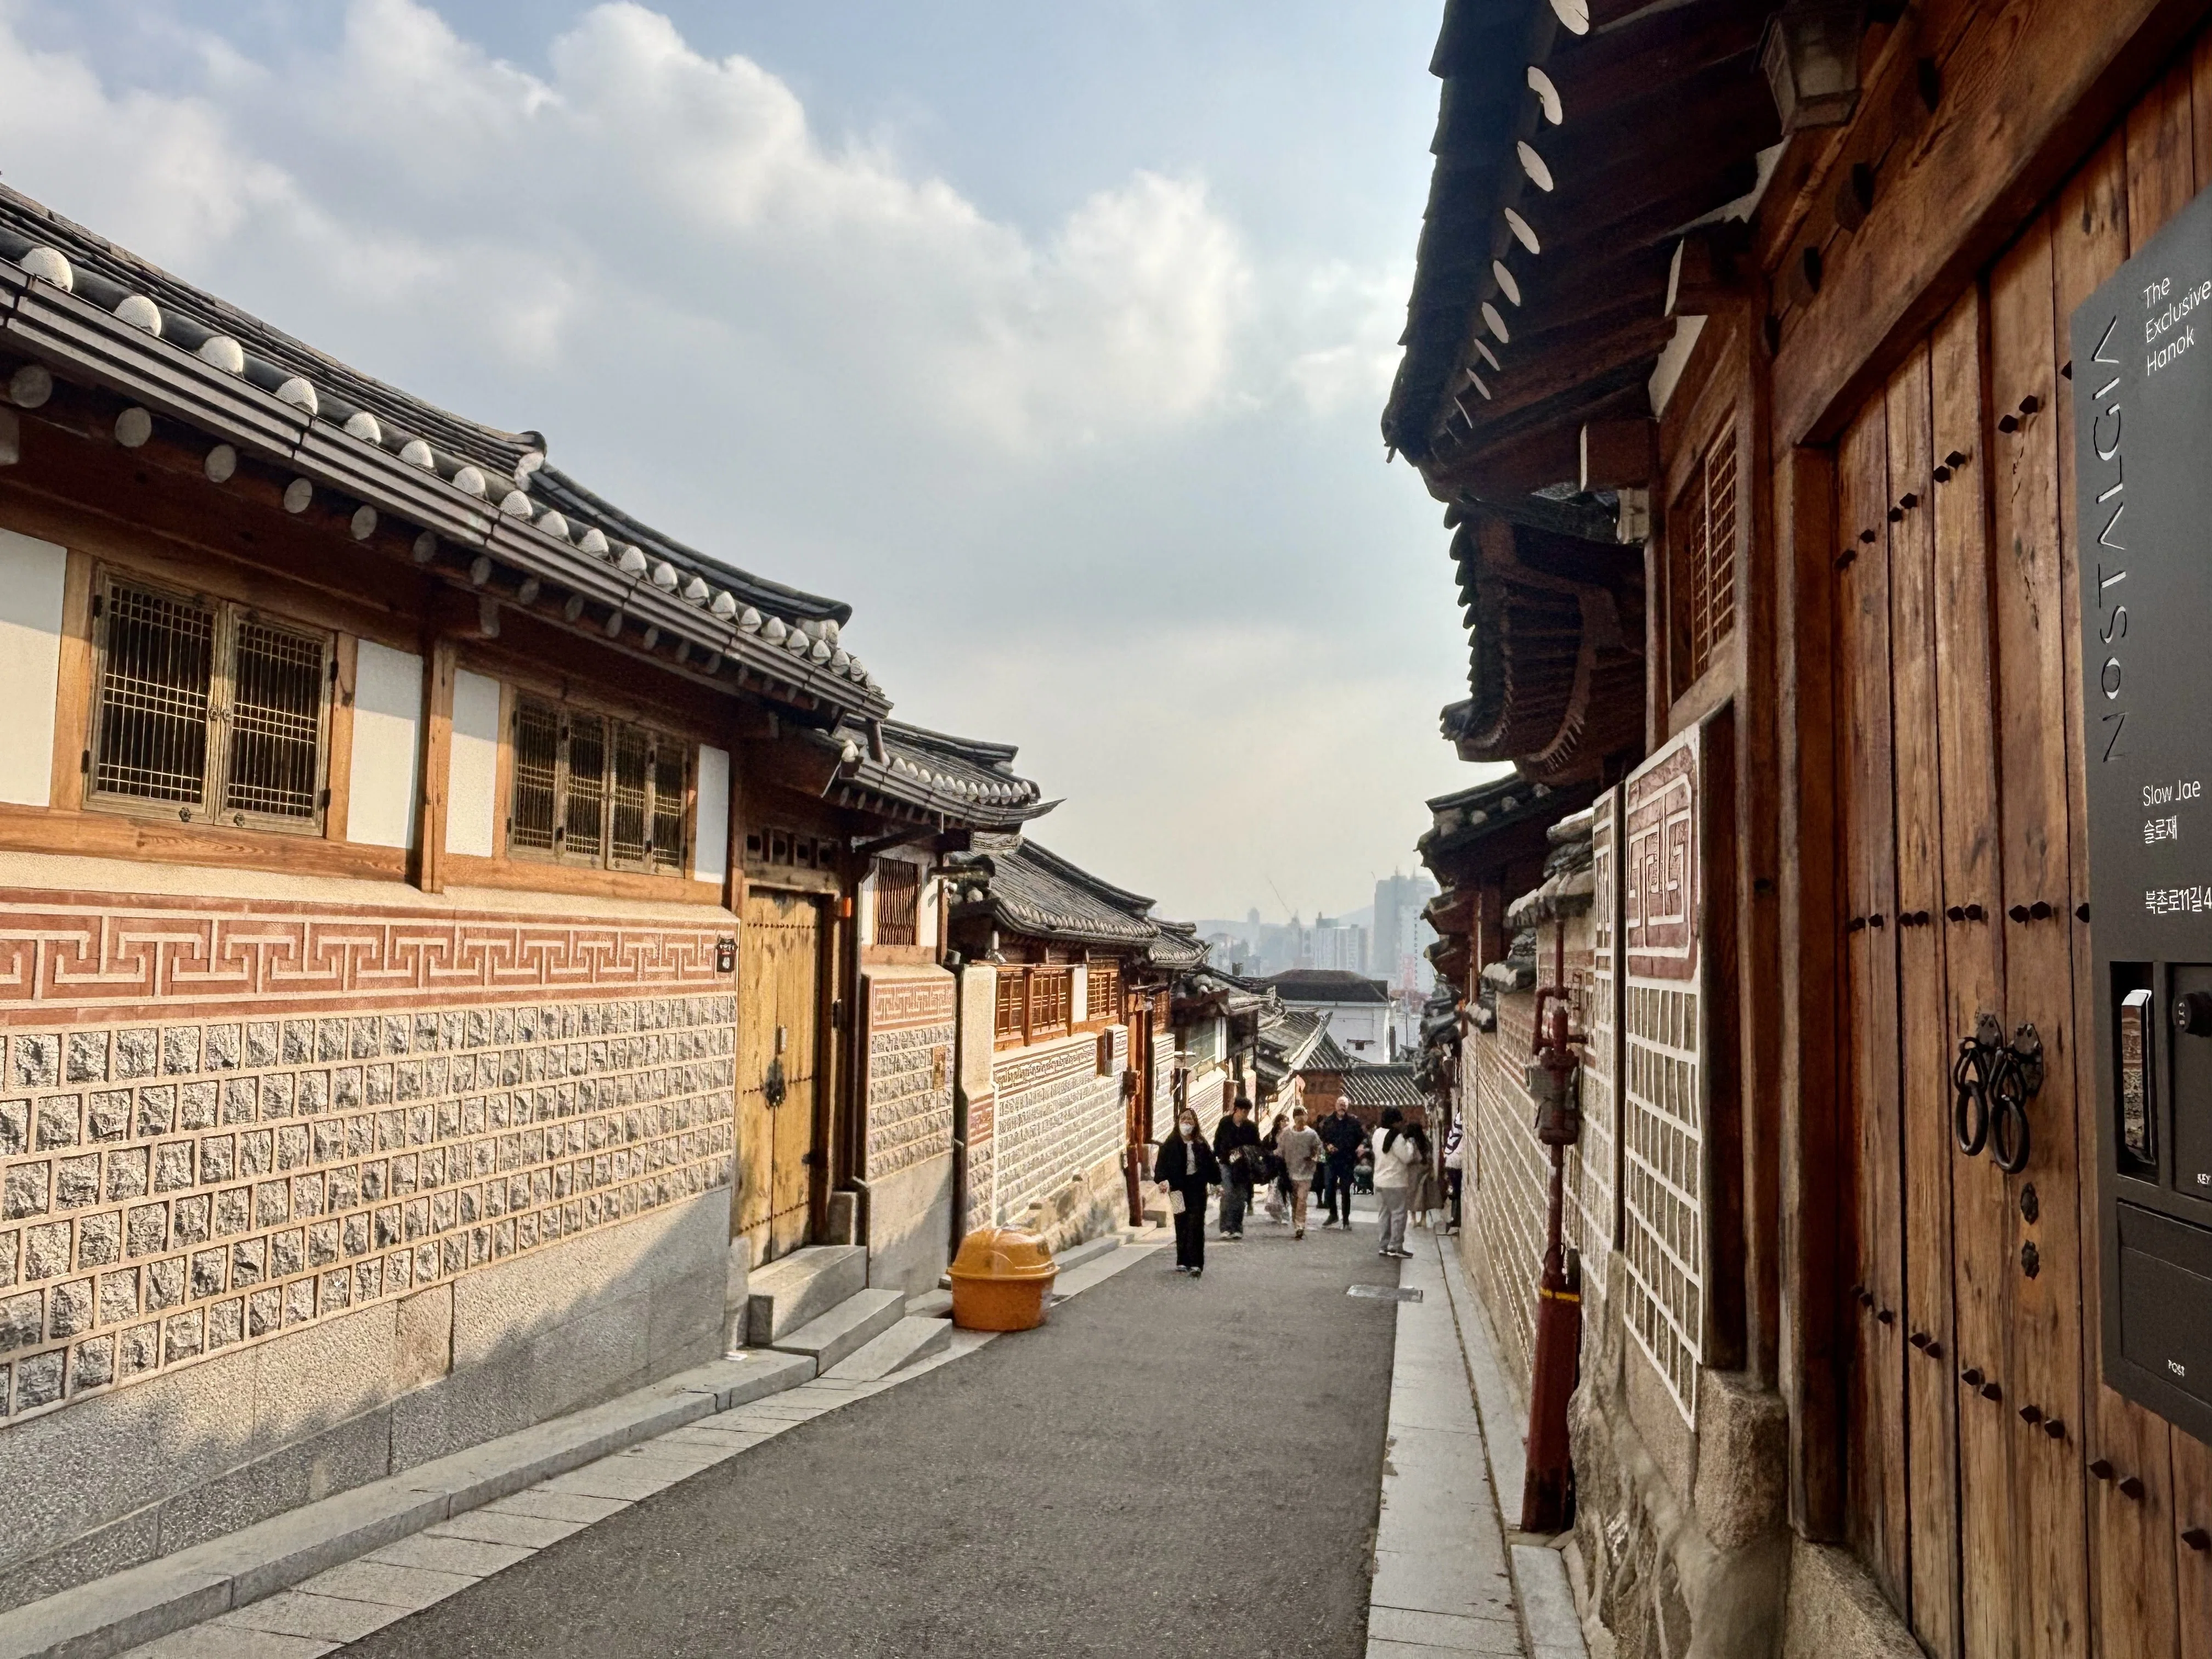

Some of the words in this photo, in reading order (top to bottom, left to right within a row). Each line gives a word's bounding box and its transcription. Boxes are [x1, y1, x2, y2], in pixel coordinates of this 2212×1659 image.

[2143, 277, 2170, 309] The
[2146, 280, 2212, 343] Exclusive
[2147, 325, 2194, 376] Hanok
[2143, 785, 2172, 806] Slow
[2175, 779, 2201, 801] Jae
[2143, 815, 2177, 844] 슬로재
